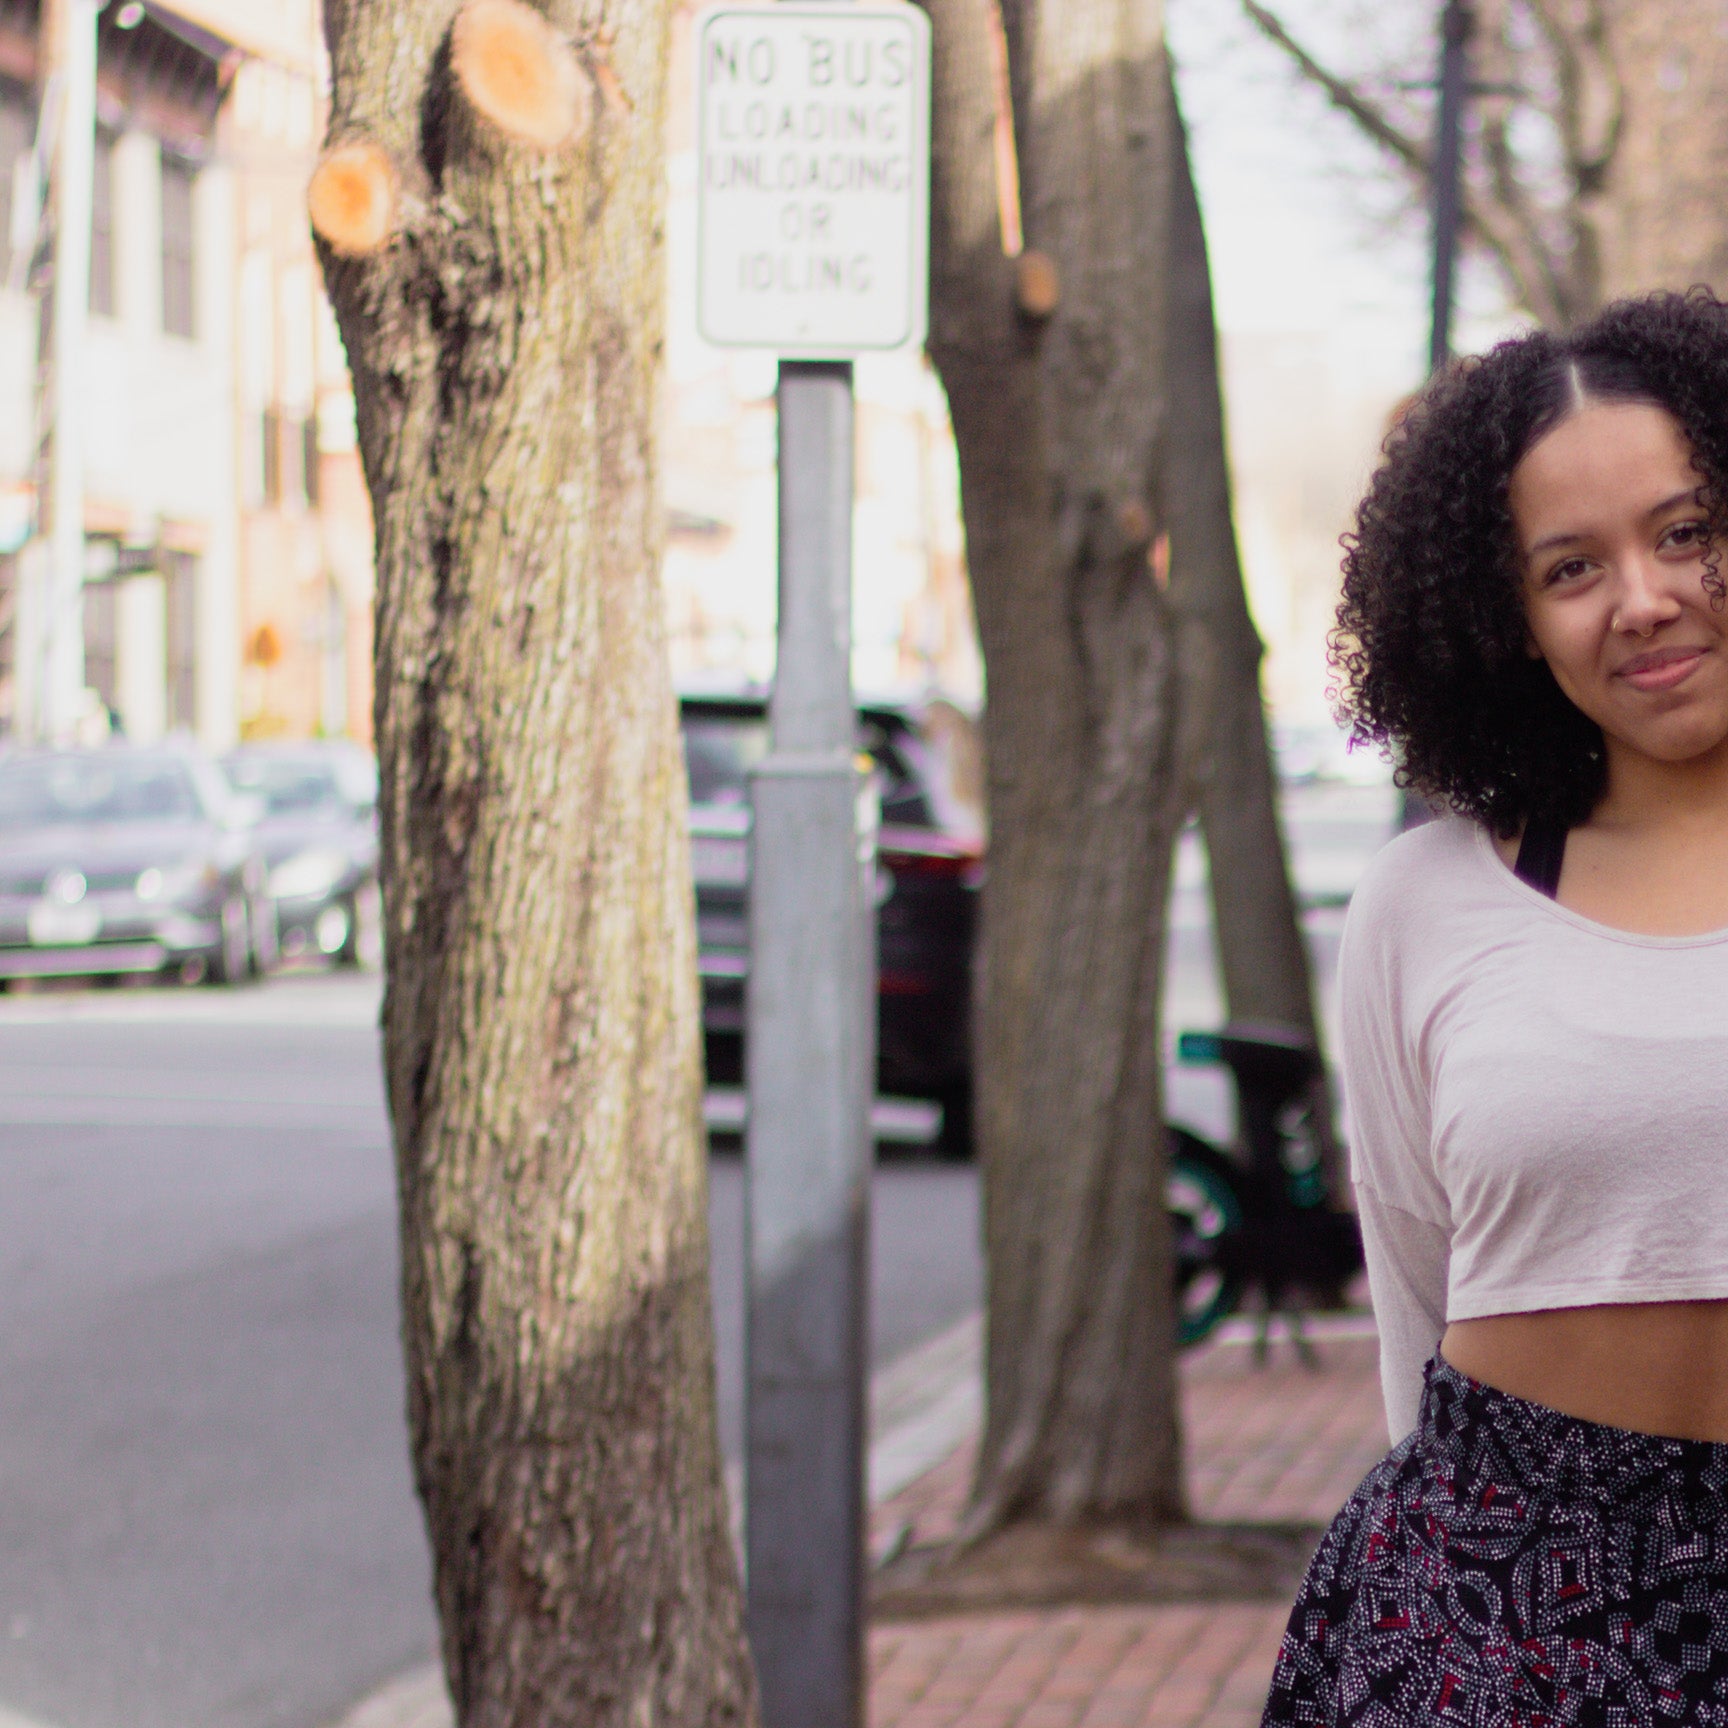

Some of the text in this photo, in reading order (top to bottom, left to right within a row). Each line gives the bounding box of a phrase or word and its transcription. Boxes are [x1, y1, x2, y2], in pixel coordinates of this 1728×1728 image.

[708, 37, 909, 87] NO BUS
[719, 102, 898, 141] LOADING
[707, 153, 910, 192] UNLOADING
[781, 202, 832, 241] OR
[740, 252, 871, 293] IDLING
